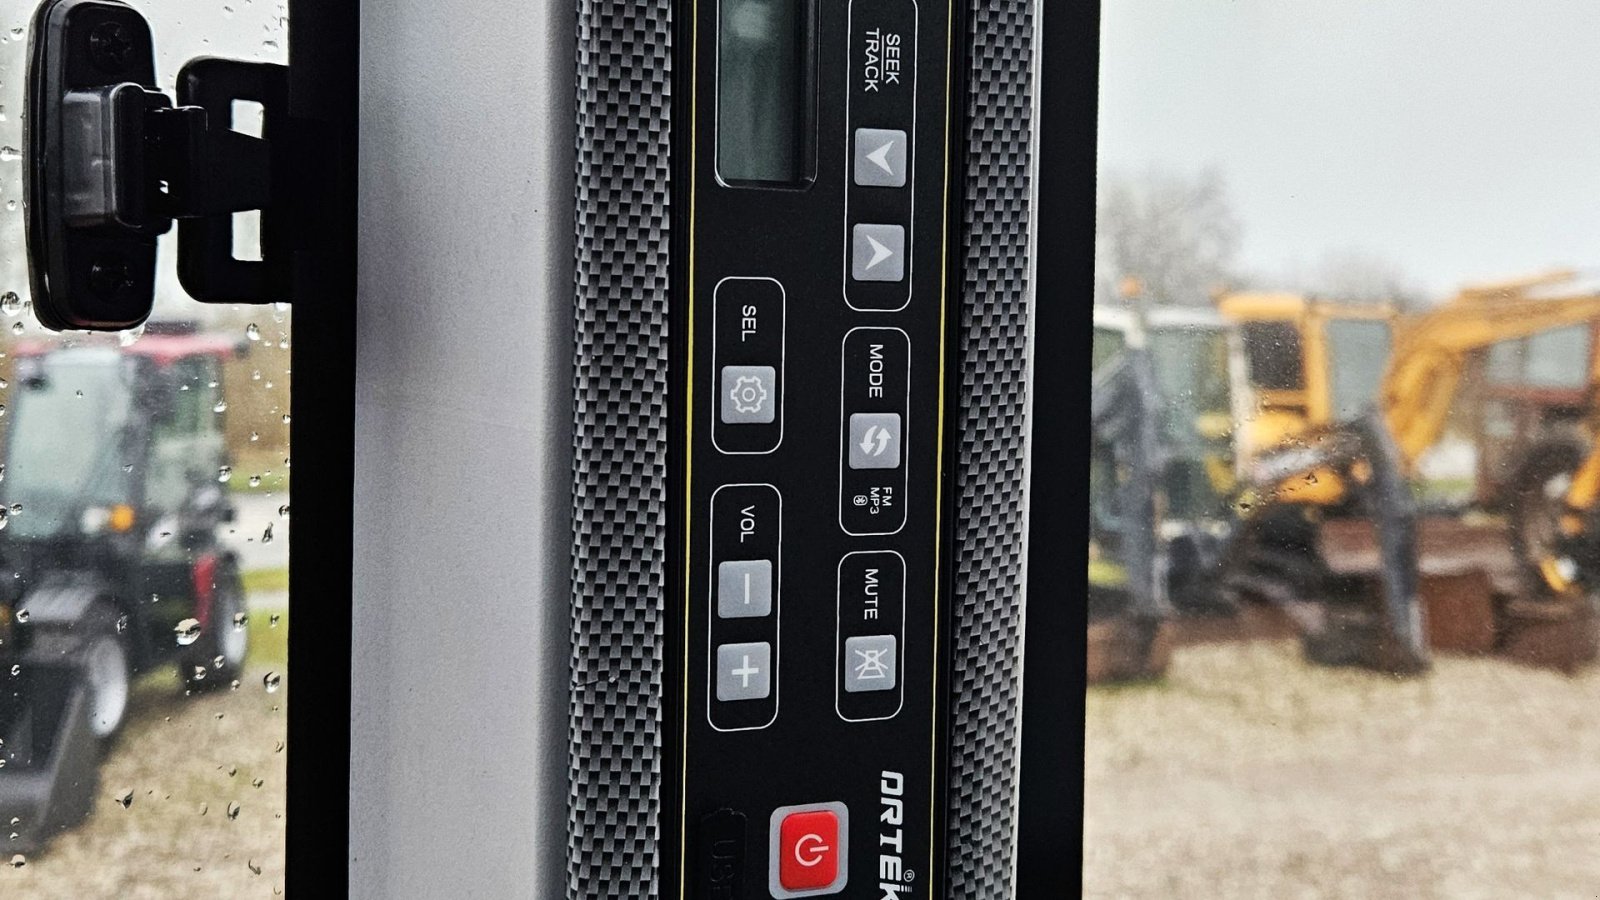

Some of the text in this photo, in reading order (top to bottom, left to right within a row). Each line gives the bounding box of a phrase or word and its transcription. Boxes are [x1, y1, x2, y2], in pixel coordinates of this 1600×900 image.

[864, 27, 880, 92] TRACK
[885, 33, 901, 85] SEEK
[741, 304, 757, 342] SEL
[868, 344, 884, 399] MODE
[869, 487, 880, 515] MP3
[882, 486, 893, 507] FM
[740, 504, 755, 543] VOL
[863, 568, 879, 620] MUTE
